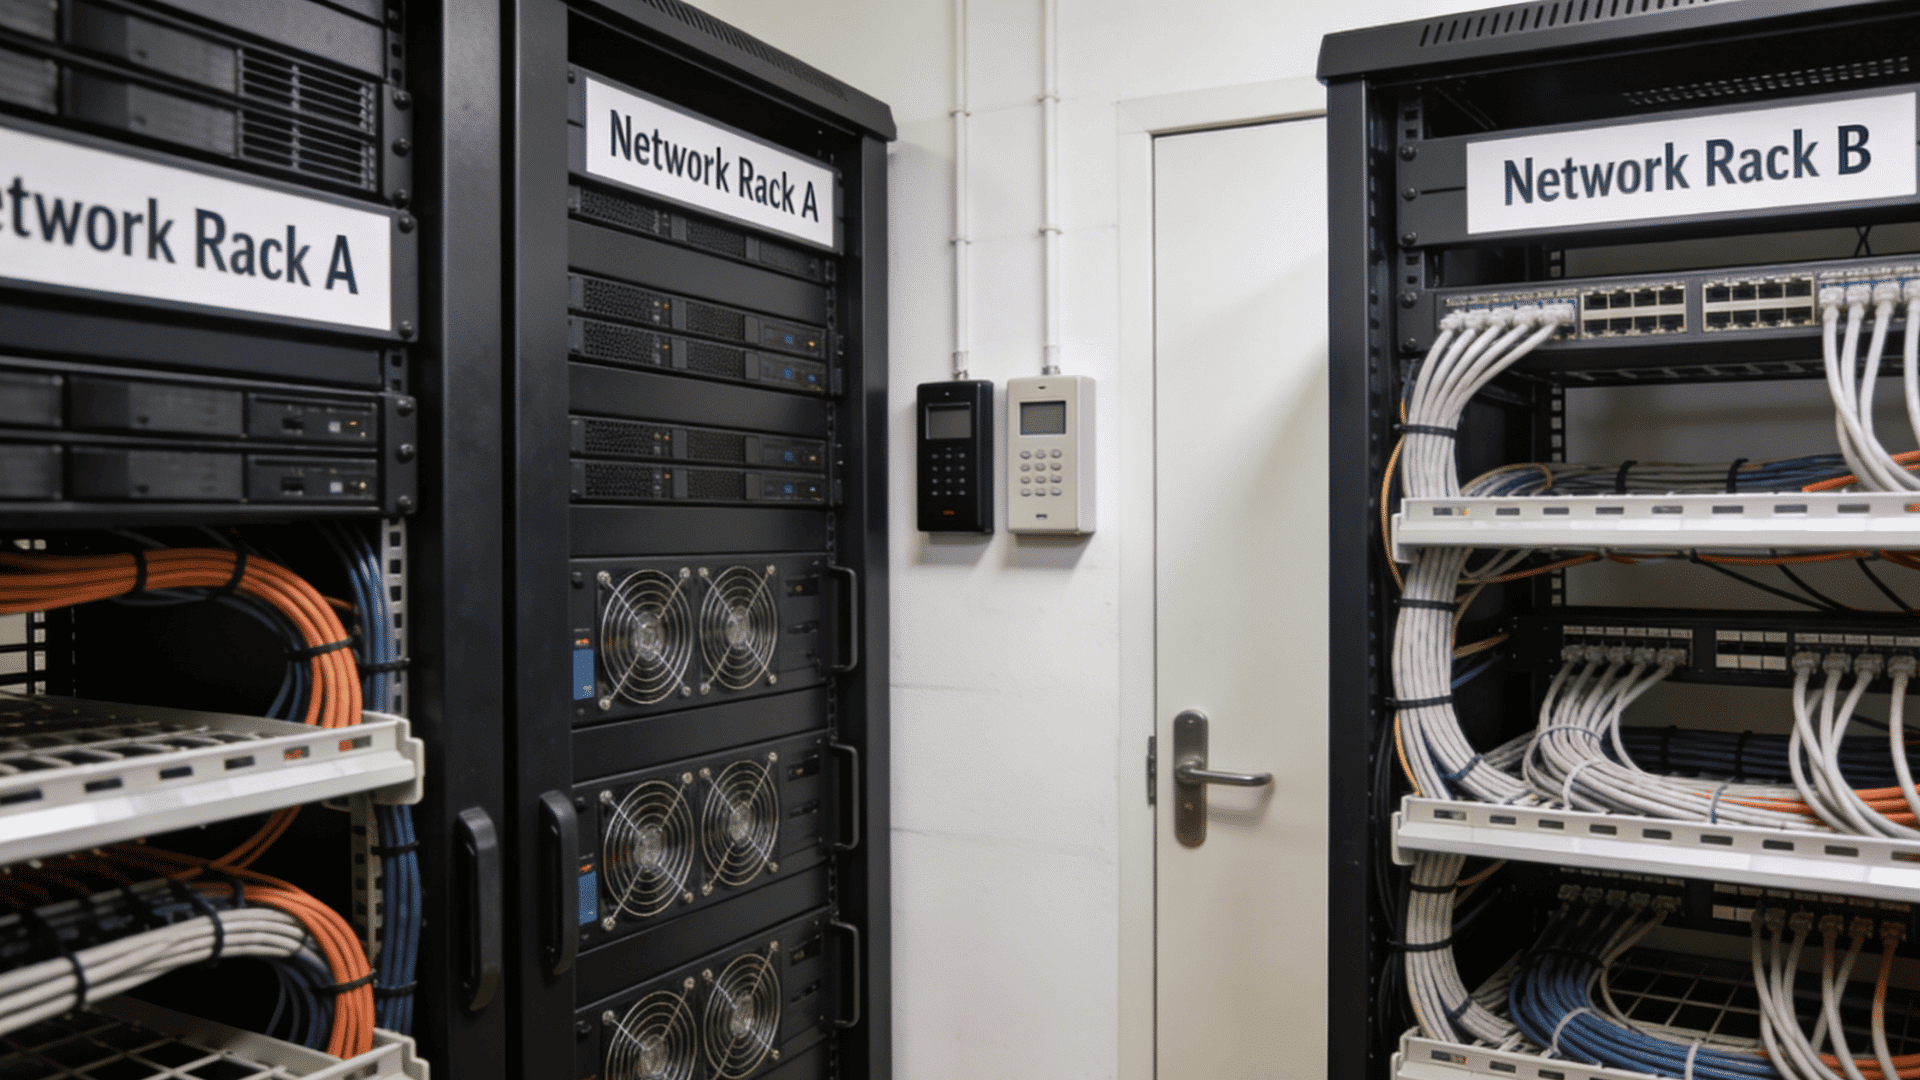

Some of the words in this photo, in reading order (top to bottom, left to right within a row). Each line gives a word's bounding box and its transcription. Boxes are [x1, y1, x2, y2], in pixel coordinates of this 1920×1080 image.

[610, 109, 730, 193] Network
[738, 156, 795, 215] Rack
[801, 180, 819, 223] A
[1504, 141, 1690, 206] Network
[1705, 128, 1820, 187] Rack
[1837, 124, 1872, 176] B
[0, 176, 176, 264] twork
[195, 207, 311, 287] Rack
[325, 234, 359, 295] A
